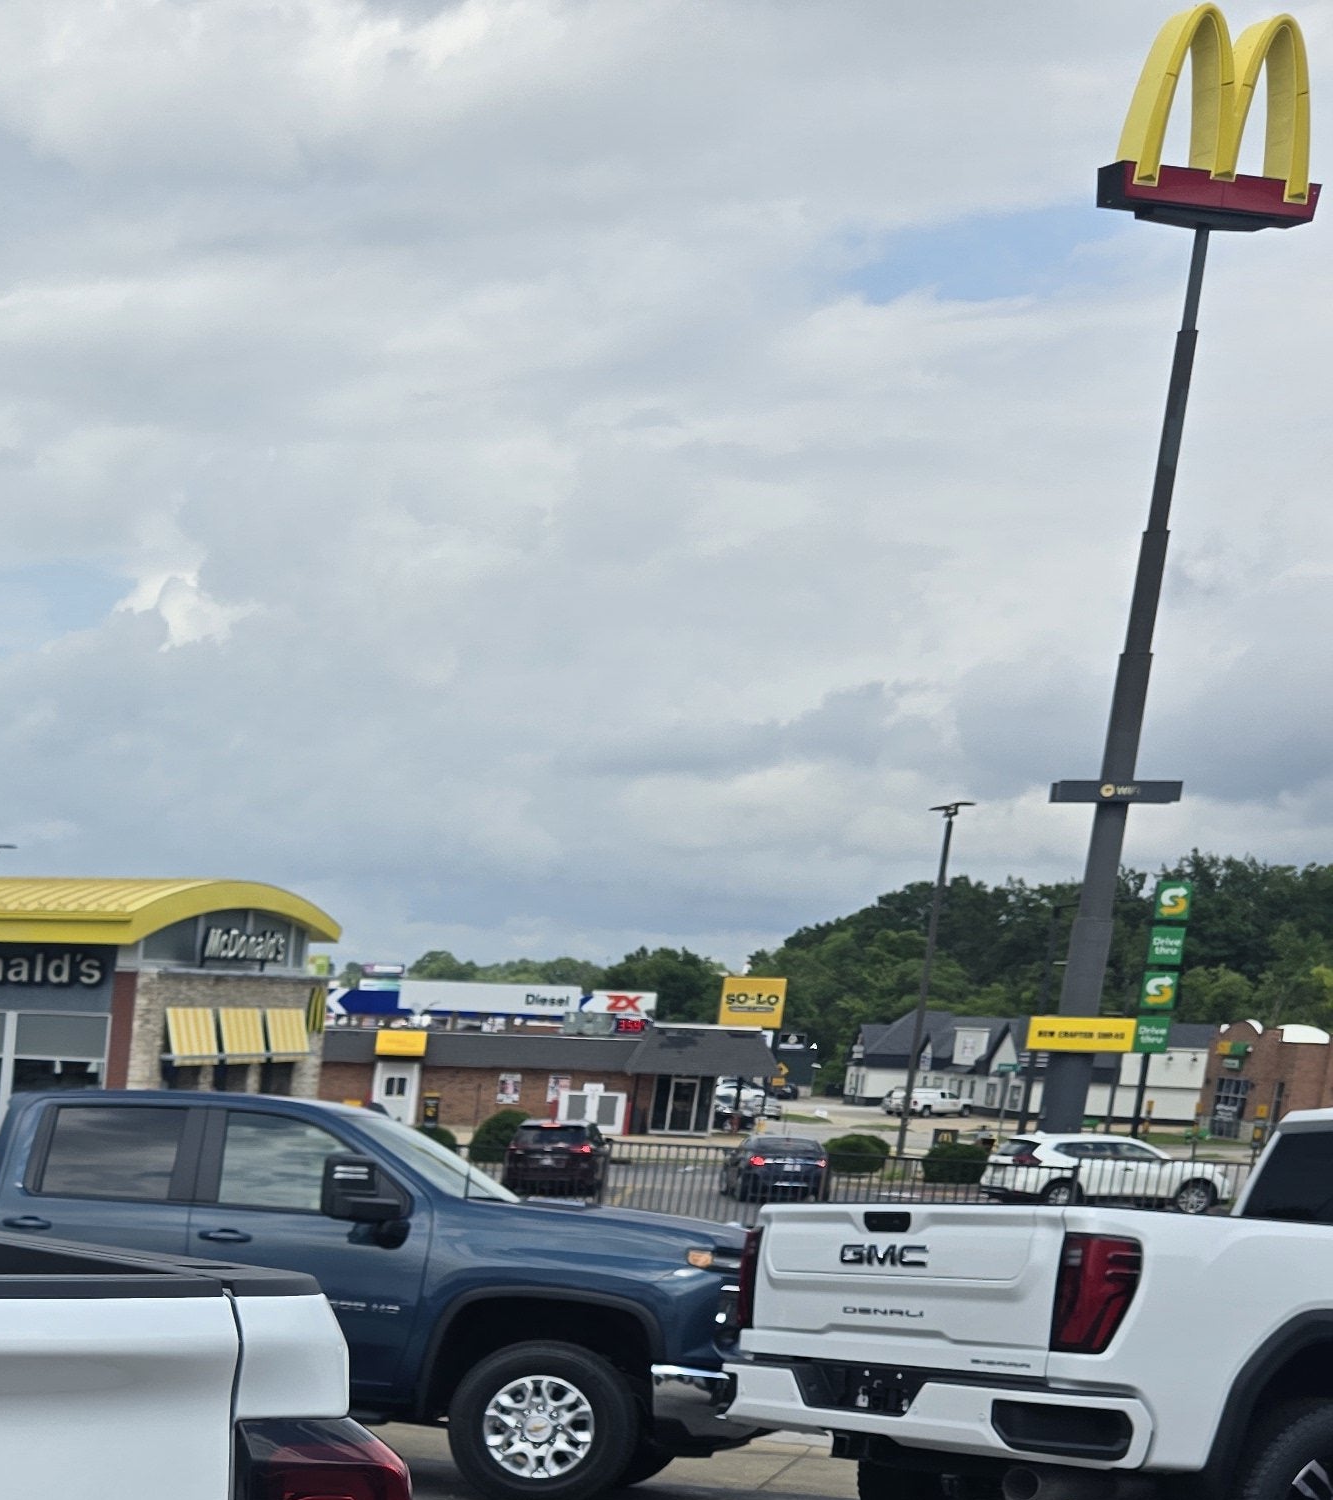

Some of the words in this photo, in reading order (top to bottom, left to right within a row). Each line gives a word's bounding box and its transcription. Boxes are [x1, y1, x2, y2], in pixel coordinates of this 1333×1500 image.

[204, 926, 287, 964] McDonald's
[1152, 936, 1182, 947] Drive
[1154, 946, 1179, 956] thru
[525, 993, 570, 1007] Diesel
[1138, 1025, 1168, 1036] Drive
[1140, 1035, 1165, 1045] thru
[839, 1243, 929, 1269] GMC
[842, 1305, 925, 1318] DENALI
